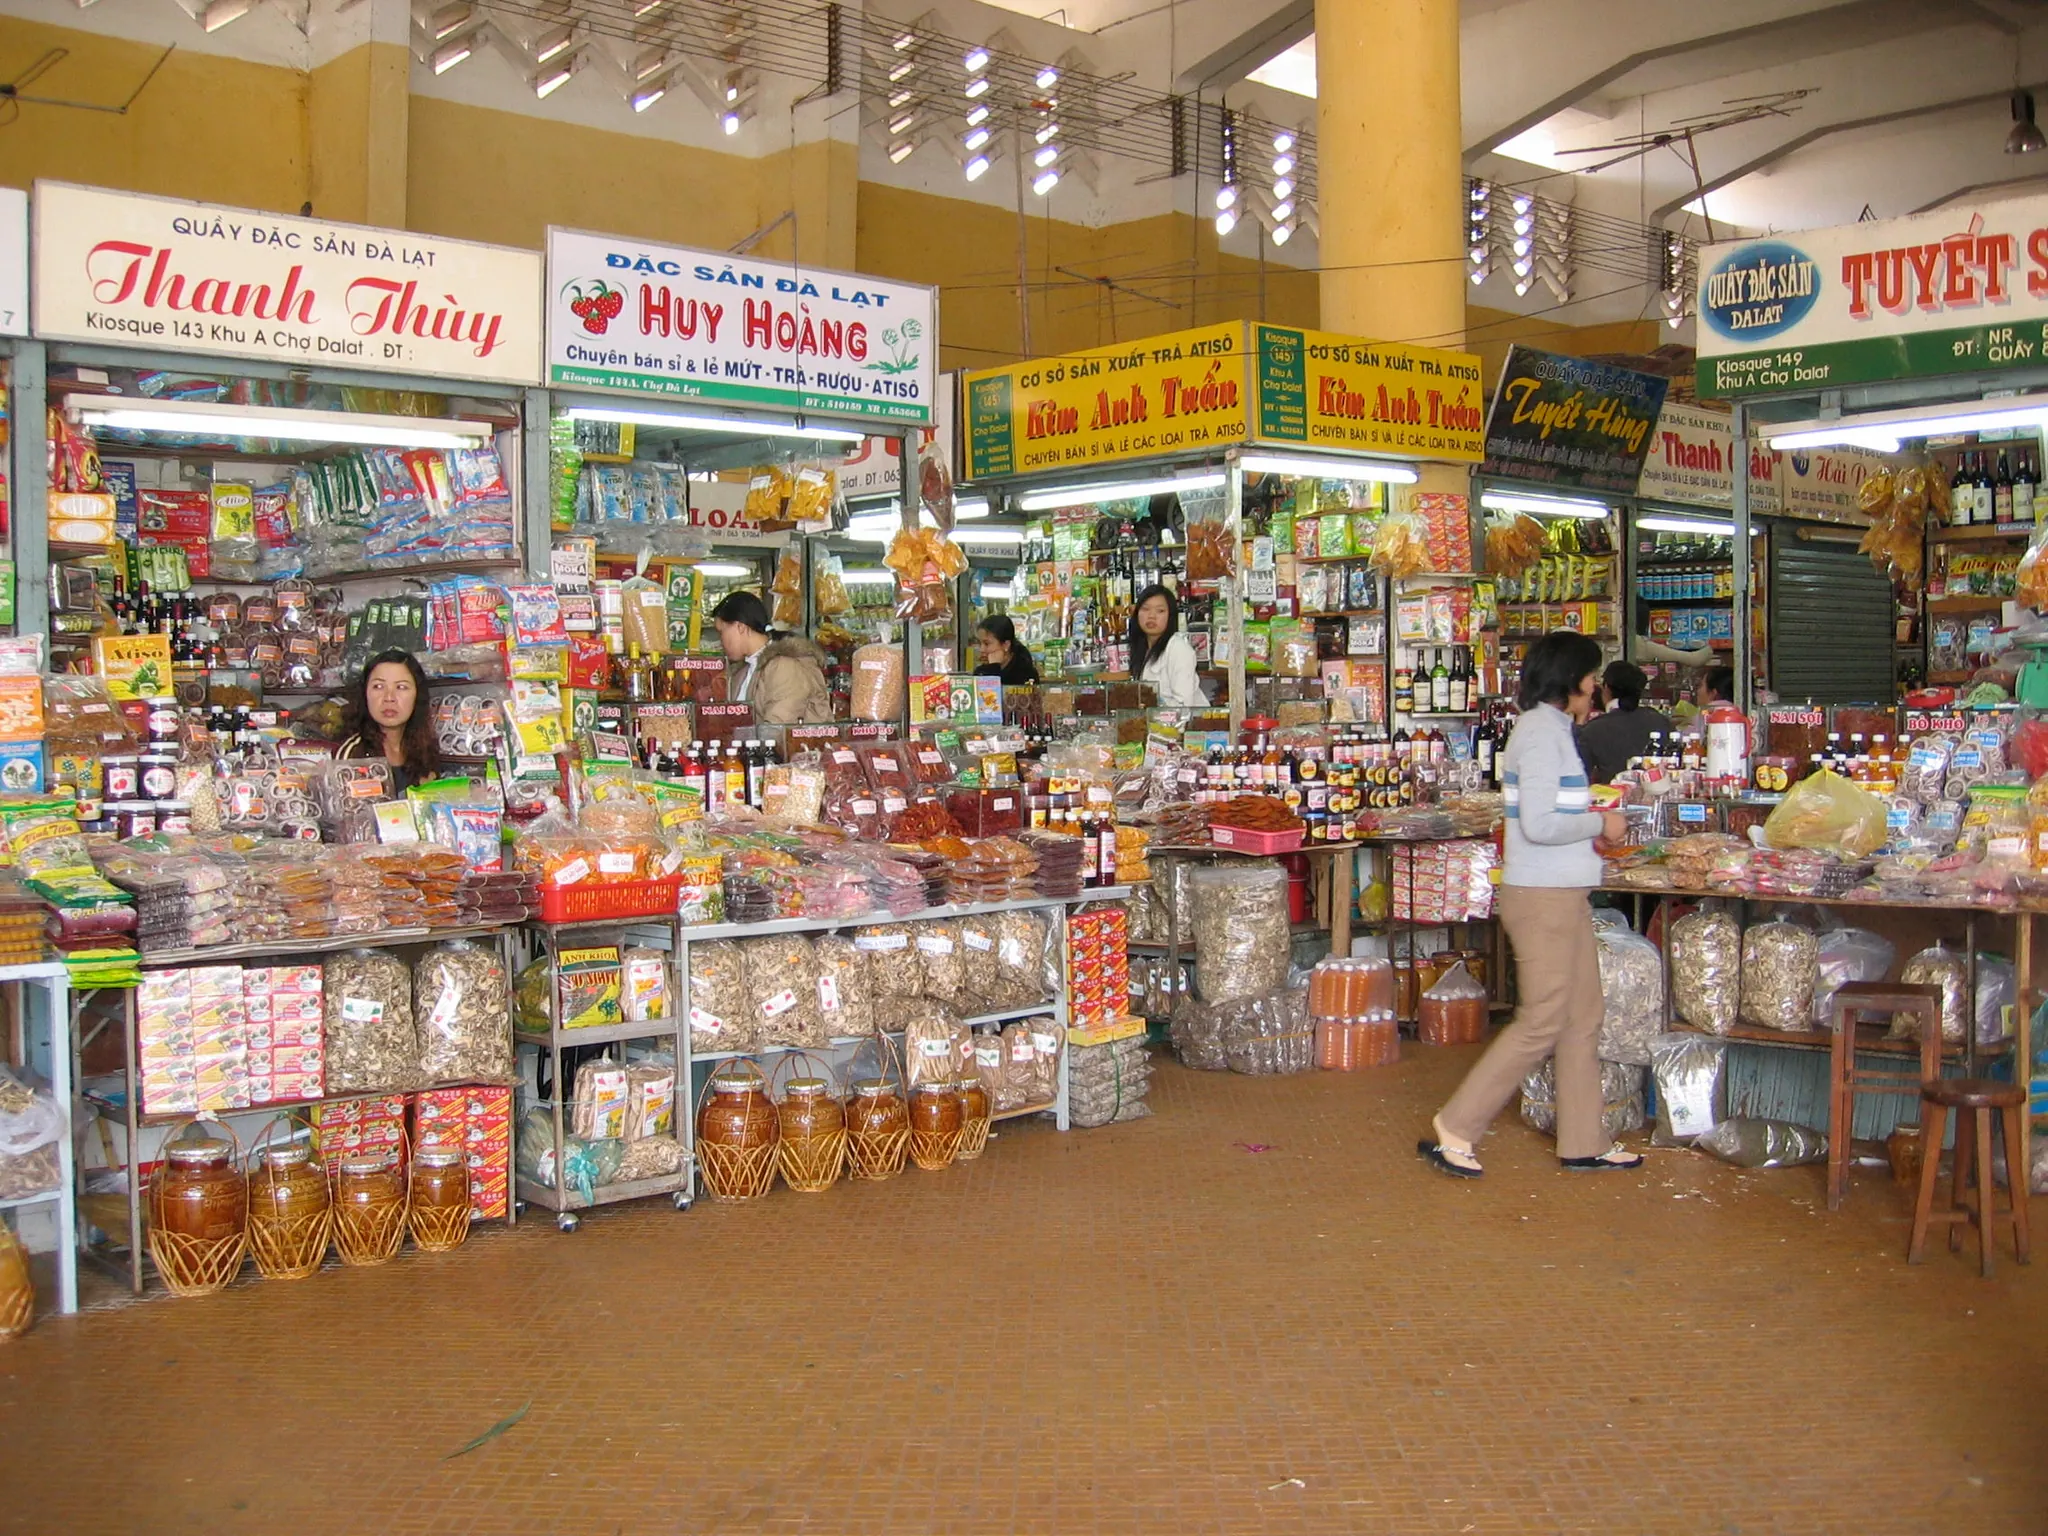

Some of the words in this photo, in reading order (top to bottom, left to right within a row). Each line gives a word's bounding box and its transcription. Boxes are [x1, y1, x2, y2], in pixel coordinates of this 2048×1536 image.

[173, 216, 241, 242] QUẦY
[251, 225, 301, 251] ĐẶC
[311, 231, 356, 257] SẢN
[365, 239, 395, 262] ĐÀ
[402, 247, 436, 269] LẠT
[605, 252, 681, 277] ĐẶC
[693, 263, 764, 290] SẢN
[775, 274, 820, 298] ĐÀ
[831, 286, 890, 309] LẠT
[1748, 257, 1776, 303] ĐẶC
[1779, 254, 1814, 301] SẢN
[1841, 212, 2018, 322] TUYẾT
[86, 240, 320, 325] Thanh
[345, 275, 507, 358] Thùy
[86, 311, 165, 337] Kiosque
[172, 319, 204, 340] 143
[211, 322, 246, 345] Khu
[253, 328, 267, 346] A
[273, 330, 312, 353] Chợ
[317, 333, 364, 356] Dalat
[638, 282, 724, 344] HUY
[742, 296, 868, 363] HOÀNG
[1988, 328, 2013, 345] NR
[566, 344, 628, 366] Chuyên
[634, 351, 663, 370] bán
[667, 353, 681, 371] sỉ
[686, 358, 697, 373] &
[703, 357, 718, 376] lẻ
[1020, 370, 1041, 388] CƠ
[1046, 363, 1065, 385] SỞ
[1070, 359, 1100, 380] SẢN
[1108, 347, 1147, 372] XUẤT
[1152, 343, 1183, 364] TRÀ
[1190, 333, 1234, 358] ATISÔ
[1309, 344, 1329, 360] CƠ
[1333, 344, 1350, 363] SỞ
[1355, 346, 1380, 367] SẢN
[1384, 351, 1414, 373] XUẤT
[1419, 357, 1443, 377] TRÀ
[1447, 364, 1479, 382] ATISÔ
[1716, 357, 1772, 375] Kiosque
[1775, 351, 1803, 368] 149
[1716, 373, 1743, 390] Khu
[1745, 372, 1756, 388] A
[1760, 368, 1789, 387] Chợ
[1793, 364, 1830, 382] Dalat
[562, 371, 605, 386] Kiosque
[643, 379, 664, 394] Chợ
[665, 382, 681, 393] Đà
[683, 383, 701, 397] Lạt
[1025, 398, 1078, 440] Kim
[1089, 382, 1148, 431] Anh
[1161, 358, 1240, 418] Tuấn
[1317, 375, 1365, 421] Kim
[1371, 383, 1422, 426] Anh
[1426, 384, 1482, 433] Tuấn
[1190, 423, 1209, 442] TRÀ
[1505, 377, 1584, 440] Tuyết
[1585, 397, 1649, 453] Hùng
[1662, 431, 1722, 474] Thanh
[1769, 710, 1796, 725] NAI
[563, 952, 586, 965] ANH
[589, 951, 618, 962] KHOA
